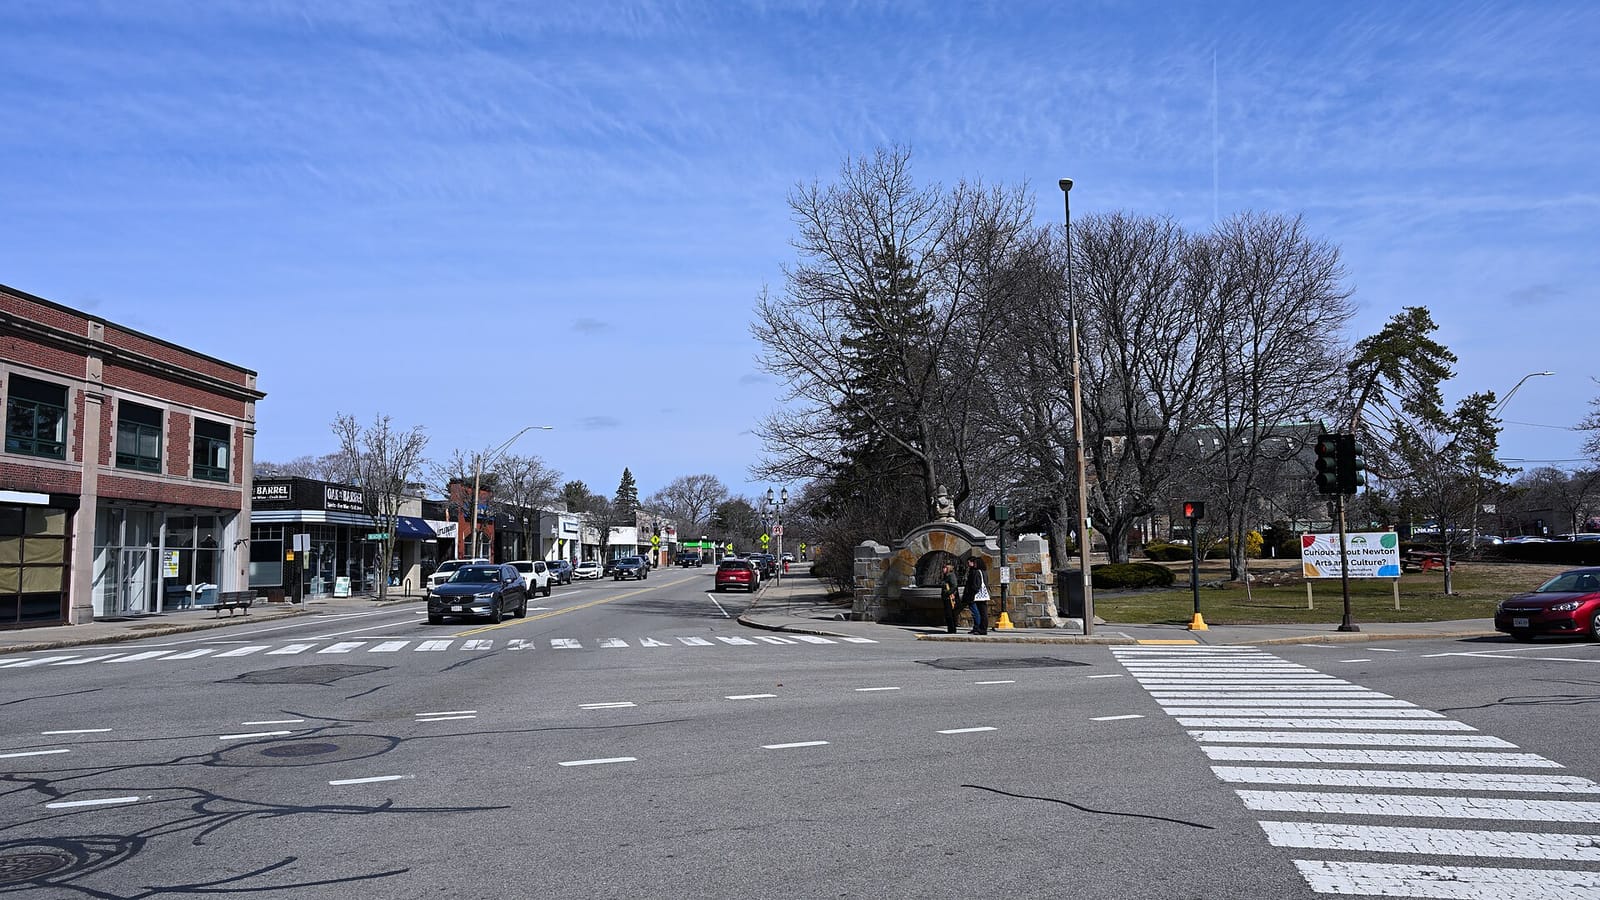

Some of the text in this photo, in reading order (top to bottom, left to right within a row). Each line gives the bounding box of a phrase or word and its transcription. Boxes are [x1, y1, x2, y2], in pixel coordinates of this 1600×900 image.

[256, 486, 289, 494] BARREL
[327, 488, 338, 500] OAK
[1336, 548, 1360, 556] aout
[1315, 559, 1332, 567] Arts
[1350, 558, 1387, 566] Culture?
